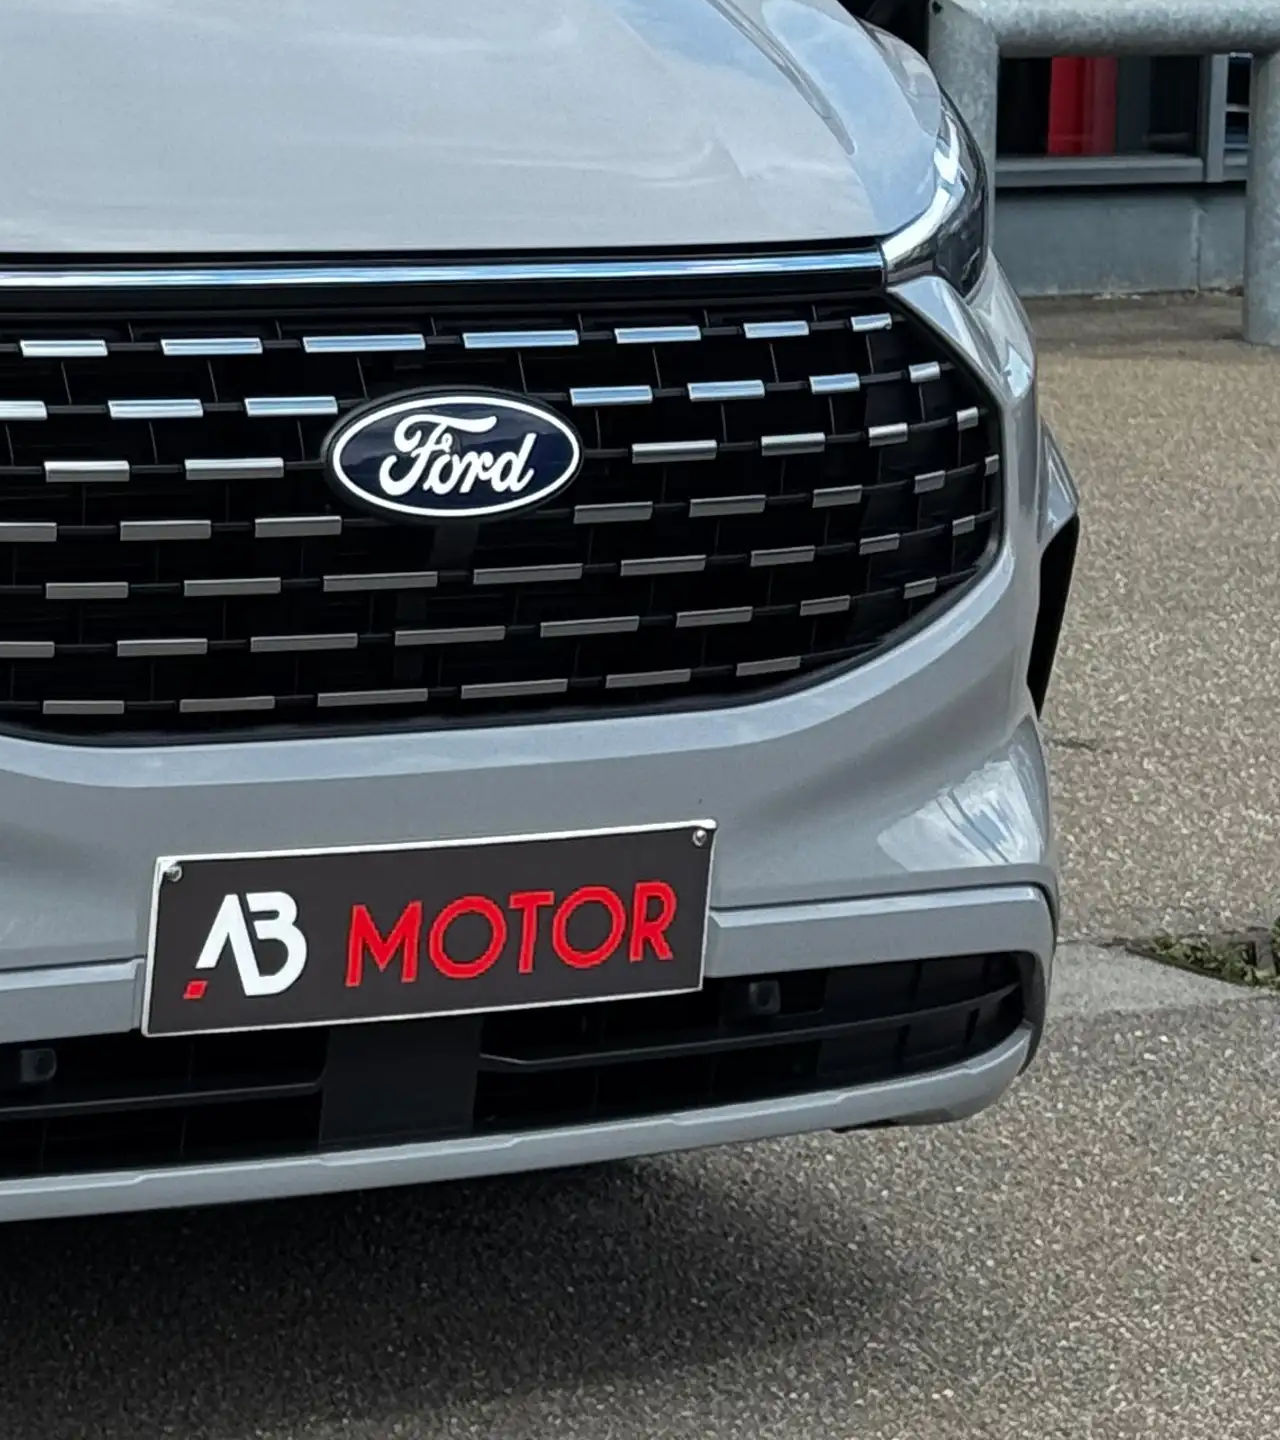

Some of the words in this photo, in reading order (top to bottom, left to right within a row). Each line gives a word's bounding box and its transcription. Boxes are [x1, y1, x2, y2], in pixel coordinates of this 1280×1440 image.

[378, 413, 538, 497] Ford
[194, 890, 308, 997] AB
[344, 879, 678, 988] MOTOR
